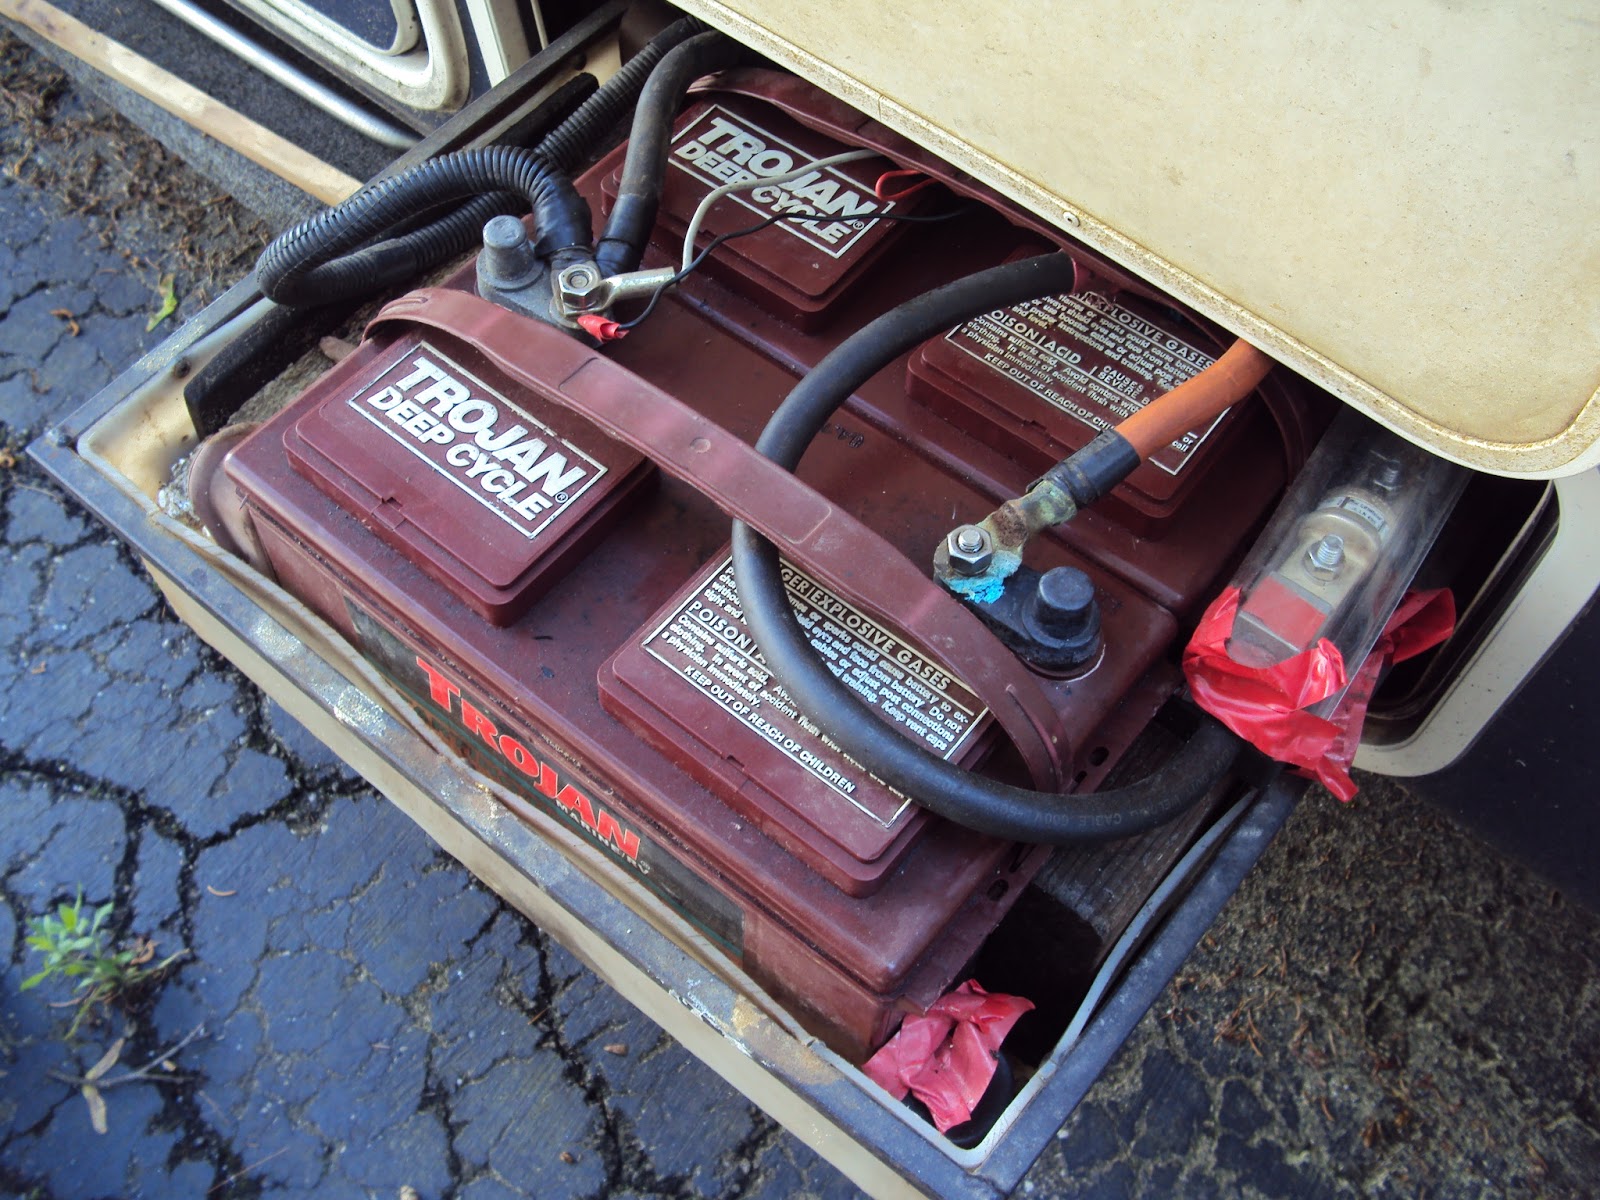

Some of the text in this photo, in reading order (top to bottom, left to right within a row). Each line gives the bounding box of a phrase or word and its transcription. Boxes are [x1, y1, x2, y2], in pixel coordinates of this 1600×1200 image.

[674, 141, 852, 245] DEEP CYCLE
[698, 117, 878, 226] TROJAN
[965, 330, 1005, 356] physician
[990, 309, 1082, 367] OISON ACID
[1028, 306, 1058, 324] proper
[1057, 320, 1105, 352] instructions
[1103, 348, 1123, 361] and
[1031, 298, 1043, 306] or
[1042, 304, 1058, 316] use
[1057, 311, 1090, 333] booster
[1089, 329, 1116, 349] cables
[1116, 346, 1128, 355] or
[1127, 352, 1155, 371] adjust
[1153, 367, 1174, 382] post
[1066, 308, 1092, 325] shield
[1090, 321, 1110, 336] eyes
[1108, 332, 1126, 344] and
[1124, 340, 1143, 354] face
[1142, 350, 1164, 367] from
[1086, 310, 1098, 319] or
[1099, 317, 1126, 336] sparks
[1125, 333, 1151, 349] could
[1150, 347, 1174, 363] cause
[1165, 339, 1214, 371] GASES
[983, 352, 1094, 419] KEEP OUT OF REACH OF
[1006, 343, 1018, 353] In
[1017, 350, 1041, 367] event
[1040, 364, 1054, 373] of
[1051, 370, 1087, 394] accident
[1086, 389, 1109, 407] flush
[1109, 403, 1129, 419] with
[1171, 440, 1190, 453] call
[1007, 335, 1039, 356] sulfuric
[1061, 366, 1090, 385] Avoid
[1087, 382, 1121, 404] contact
[1182, 436, 1194, 445] or
[1097, 371, 1140, 400] SEVERE
[1102, 365, 1144, 393] CAUSES
[367, 382, 553, 521] DEEP CYCLE
[395, 356, 587, 498] TROJAN
[661, 630, 671, 639] a
[687, 600, 752, 650] POISON
[703, 588, 730, 608] tight
[665, 633, 712, 670] physician
[676, 614, 718, 646] Contains
[713, 642, 748, 670] sulfuric
[808, 611, 823, 622] or
[822, 620, 853, 644] sparks
[851, 640, 881, 662] could
[878, 659, 905, 681] cause
[904, 675, 940, 705] battery
[939, 701, 952, 713] to
[953, 710, 969, 724] ex-
[810, 589, 897, 654] EXPLOSIVE
[893, 649, 951, 693] GASES
[811, 626, 834, 646] eyes
[831, 639, 852, 656] and
[848, 650, 870, 670] face
[867, 663, 892, 685] from
[928, 705, 945, 721] Do
[943, 718, 963, 734] not
[682, 663, 713, 687] KEEP
[710, 683, 736, 704] OUT
[732, 700, 751, 715] OF
[747, 711, 787, 743] REACH
[783, 738, 803, 753] OF
[799, 747, 856, 794] CHILDREN
[711, 652, 726, 666] In
[722, 662, 749, 684] event
[747, 678, 763, 694] of
[757, 689, 798, 720] accident
[795, 714, 821, 737] flush
[810, 636, 839, 661] cables
[838, 658, 853, 670] or
[847, 667, 881, 692] adjust
[878, 686, 902, 706] post
[900, 701, 956, 743] connections
[841, 672, 883, 705] training.
[880, 699, 910, 724] Keep
[905, 717, 928, 738] vent
[925, 733, 948, 751] caps
[416, 656, 641, 861] TROJAN
